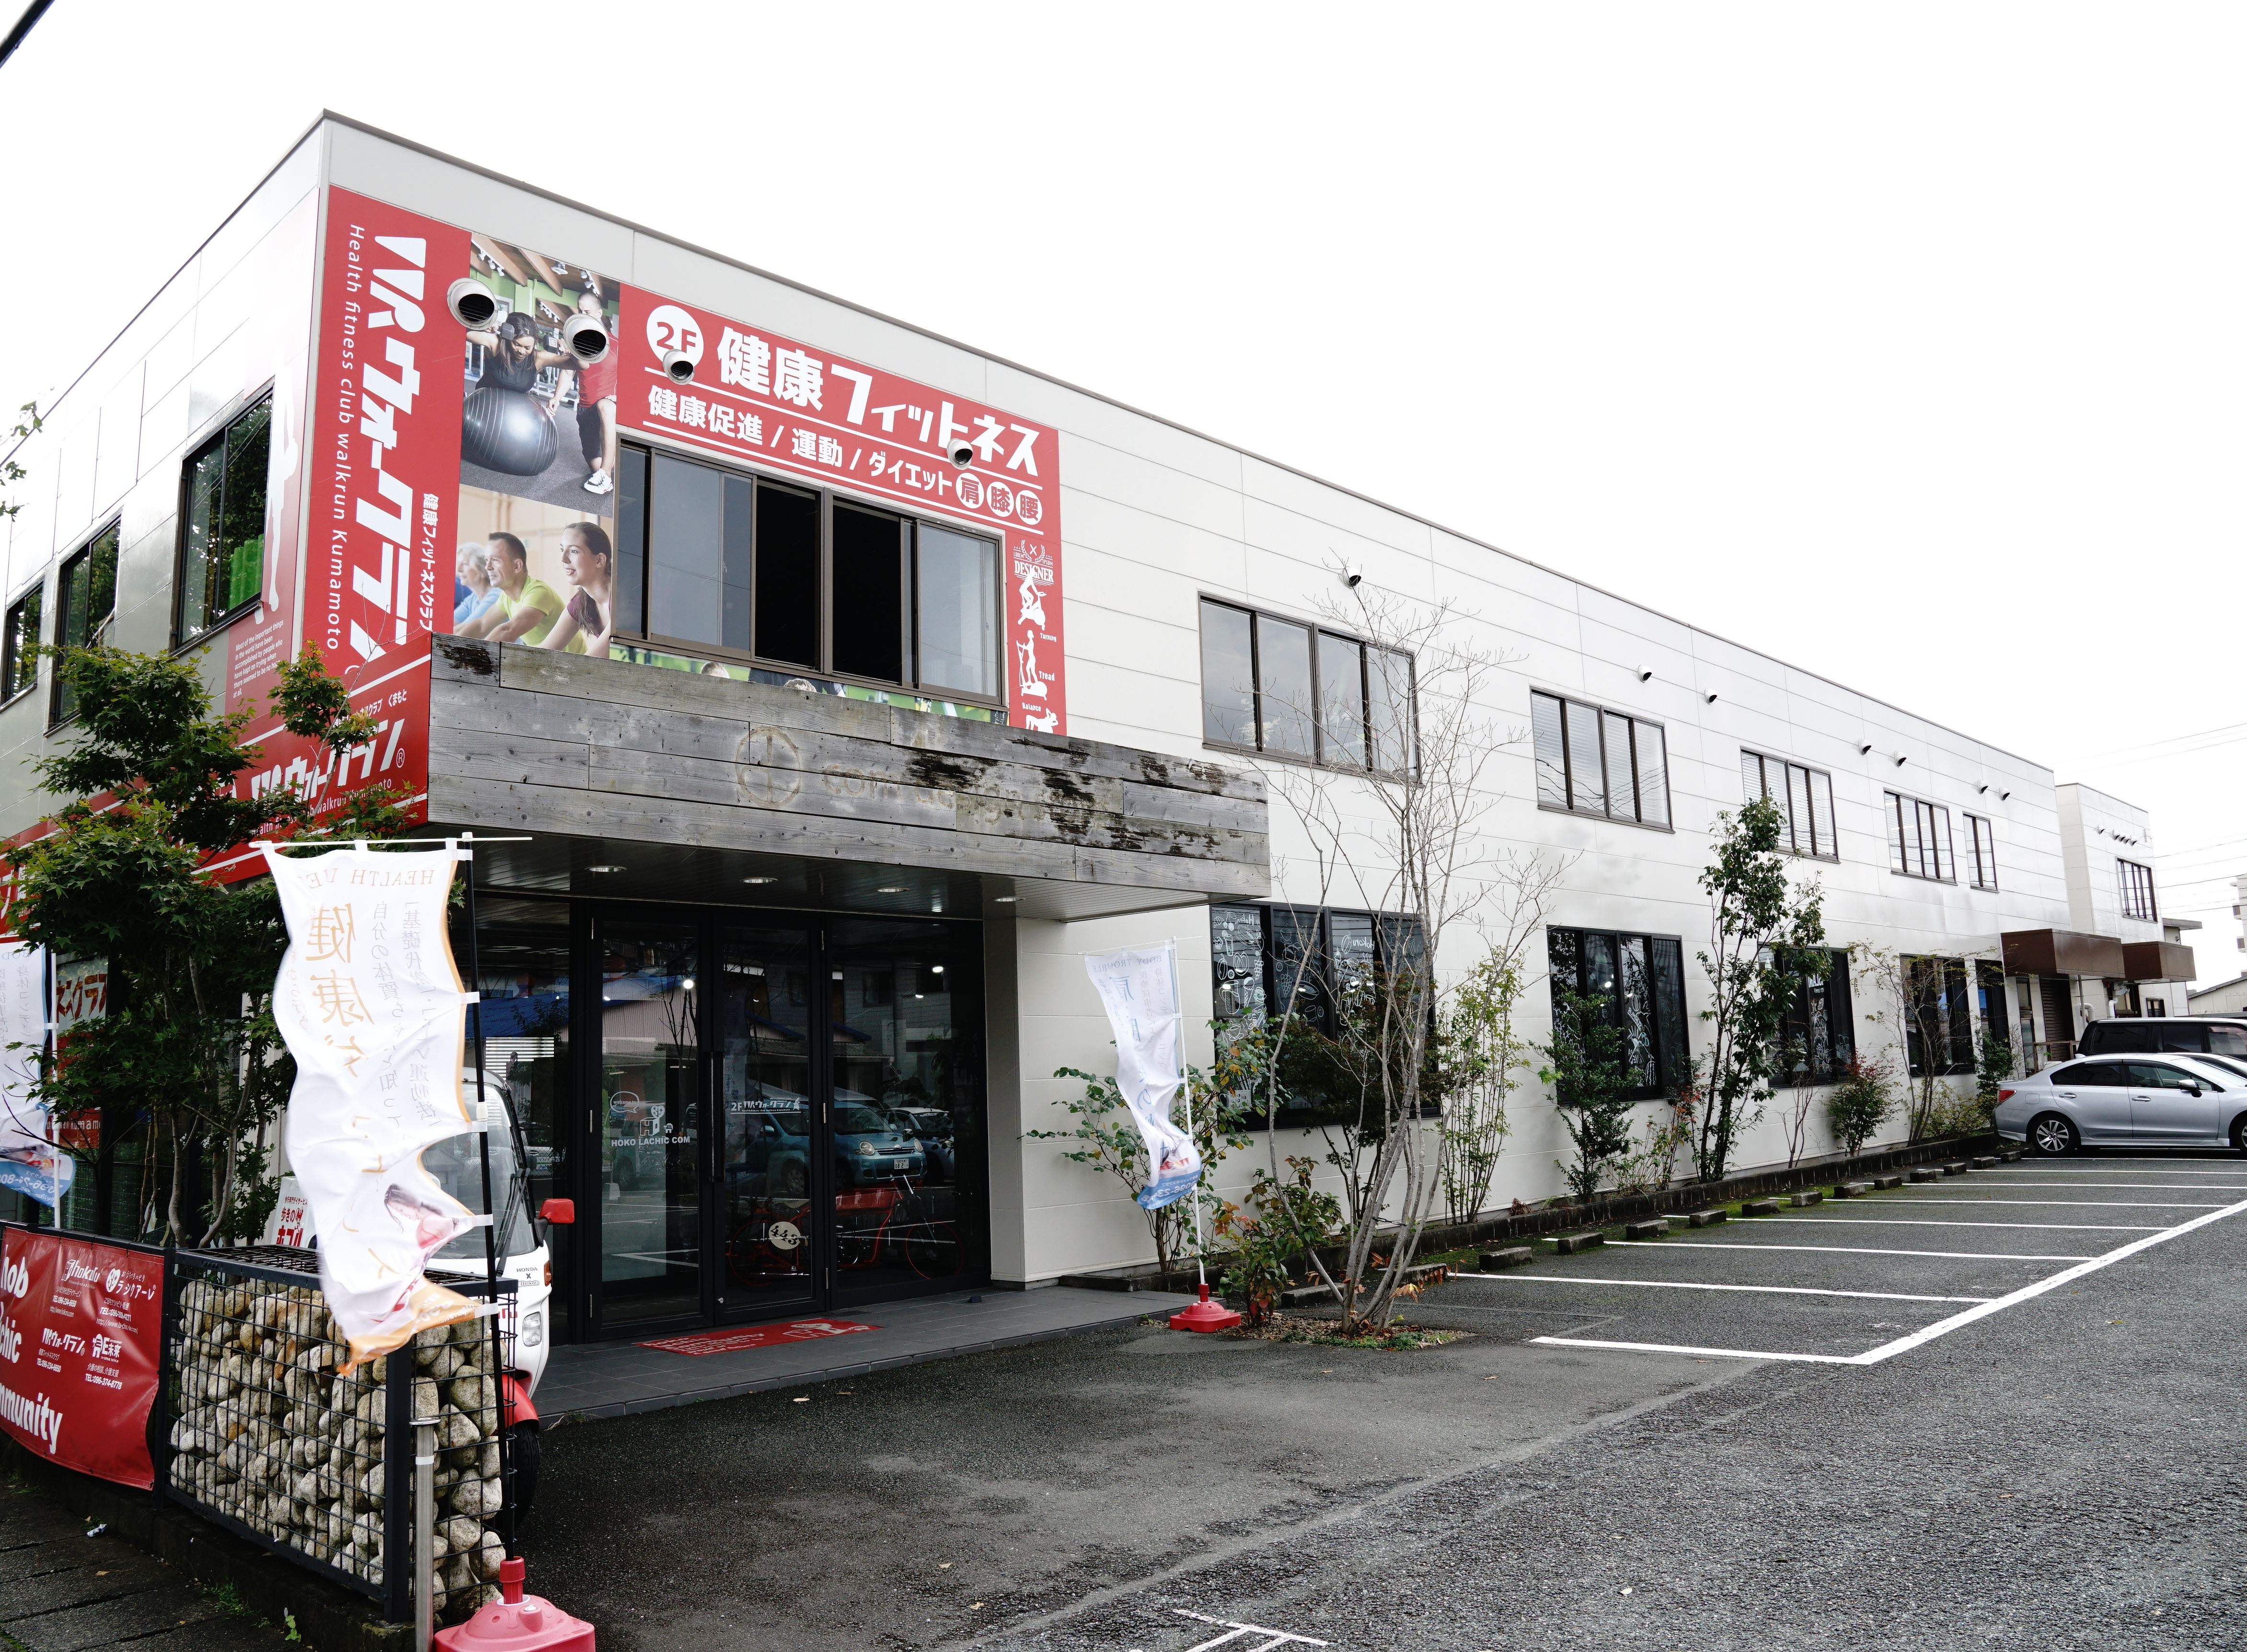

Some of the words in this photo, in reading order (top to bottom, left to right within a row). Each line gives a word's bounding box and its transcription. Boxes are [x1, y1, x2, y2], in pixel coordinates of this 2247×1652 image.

[346, 223, 365, 292] Health
[341, 301, 361, 370] fitness
[656, 321, 698, 350] 2F
[339, 379, 356, 424] club
[717, 326, 1040, 477] 健康フィットネス
[648, 385, 763, 445] 健康促進
[791, 427, 842, 468] 運動
[868, 450, 953, 496] ダイエット
[333, 433, 352, 520] walkrun
[327, 529, 348, 649] Kumamoto
[255, 626, 273, 642] important
[273, 620, 284, 632] things
[234, 654, 258, 670] accomplished
[258, 651, 263, 660] by
[263, 643, 276, 657] people
[245, 645, 255, 657] world
[255, 642, 264, 652] have
[264, 635, 273, 646] been
[234, 671, 242, 679] have
[242, 665, 251, 676] kept
[256, 658, 267, 670] trying
[267, 653, 277, 662] when
[1038, 671, 1055, 682] Tread
[233, 679, 243, 689] there
[243, 674, 257, 684] seemed
[233, 690, 237, 699] at
[388, 688, 407, 708] くまもと
[1022, 702, 1042, 712] Balance
[731, 1102, 742, 1111] 2F
[611, 1138, 636, 1147] HOKO
[638, 1137, 670, 1146] LACHIC
[281, 1206, 295, 1223] 歩きの
[770, 1225, 798, 1245] 443
[85, 1373, 123, 1390] TEL:096-374-8778
